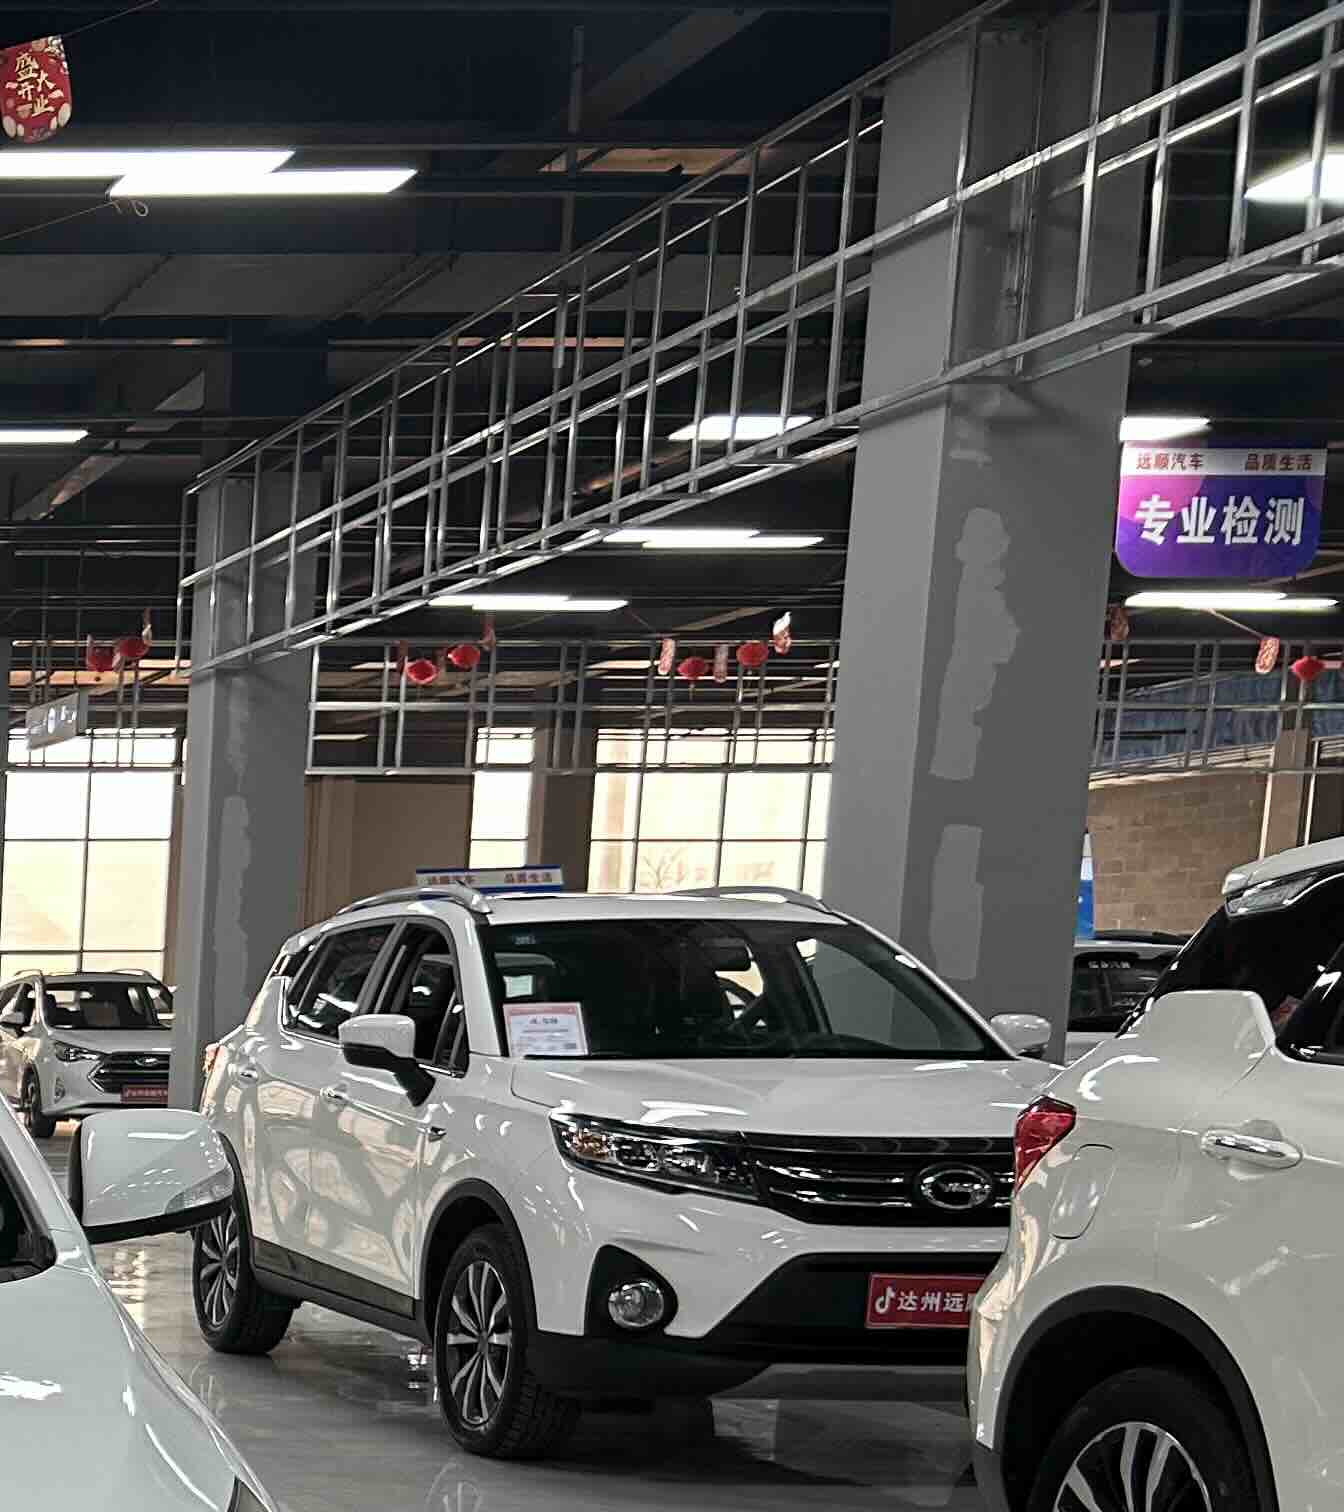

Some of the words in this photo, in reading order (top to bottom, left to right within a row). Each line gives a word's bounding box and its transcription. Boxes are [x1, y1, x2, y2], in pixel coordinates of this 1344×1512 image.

[1136, 453, 1203, 470] 远顺汽车
[1244, 453, 1312, 471] 品质生活
[1135, 494, 1304, 545] 专业检测
